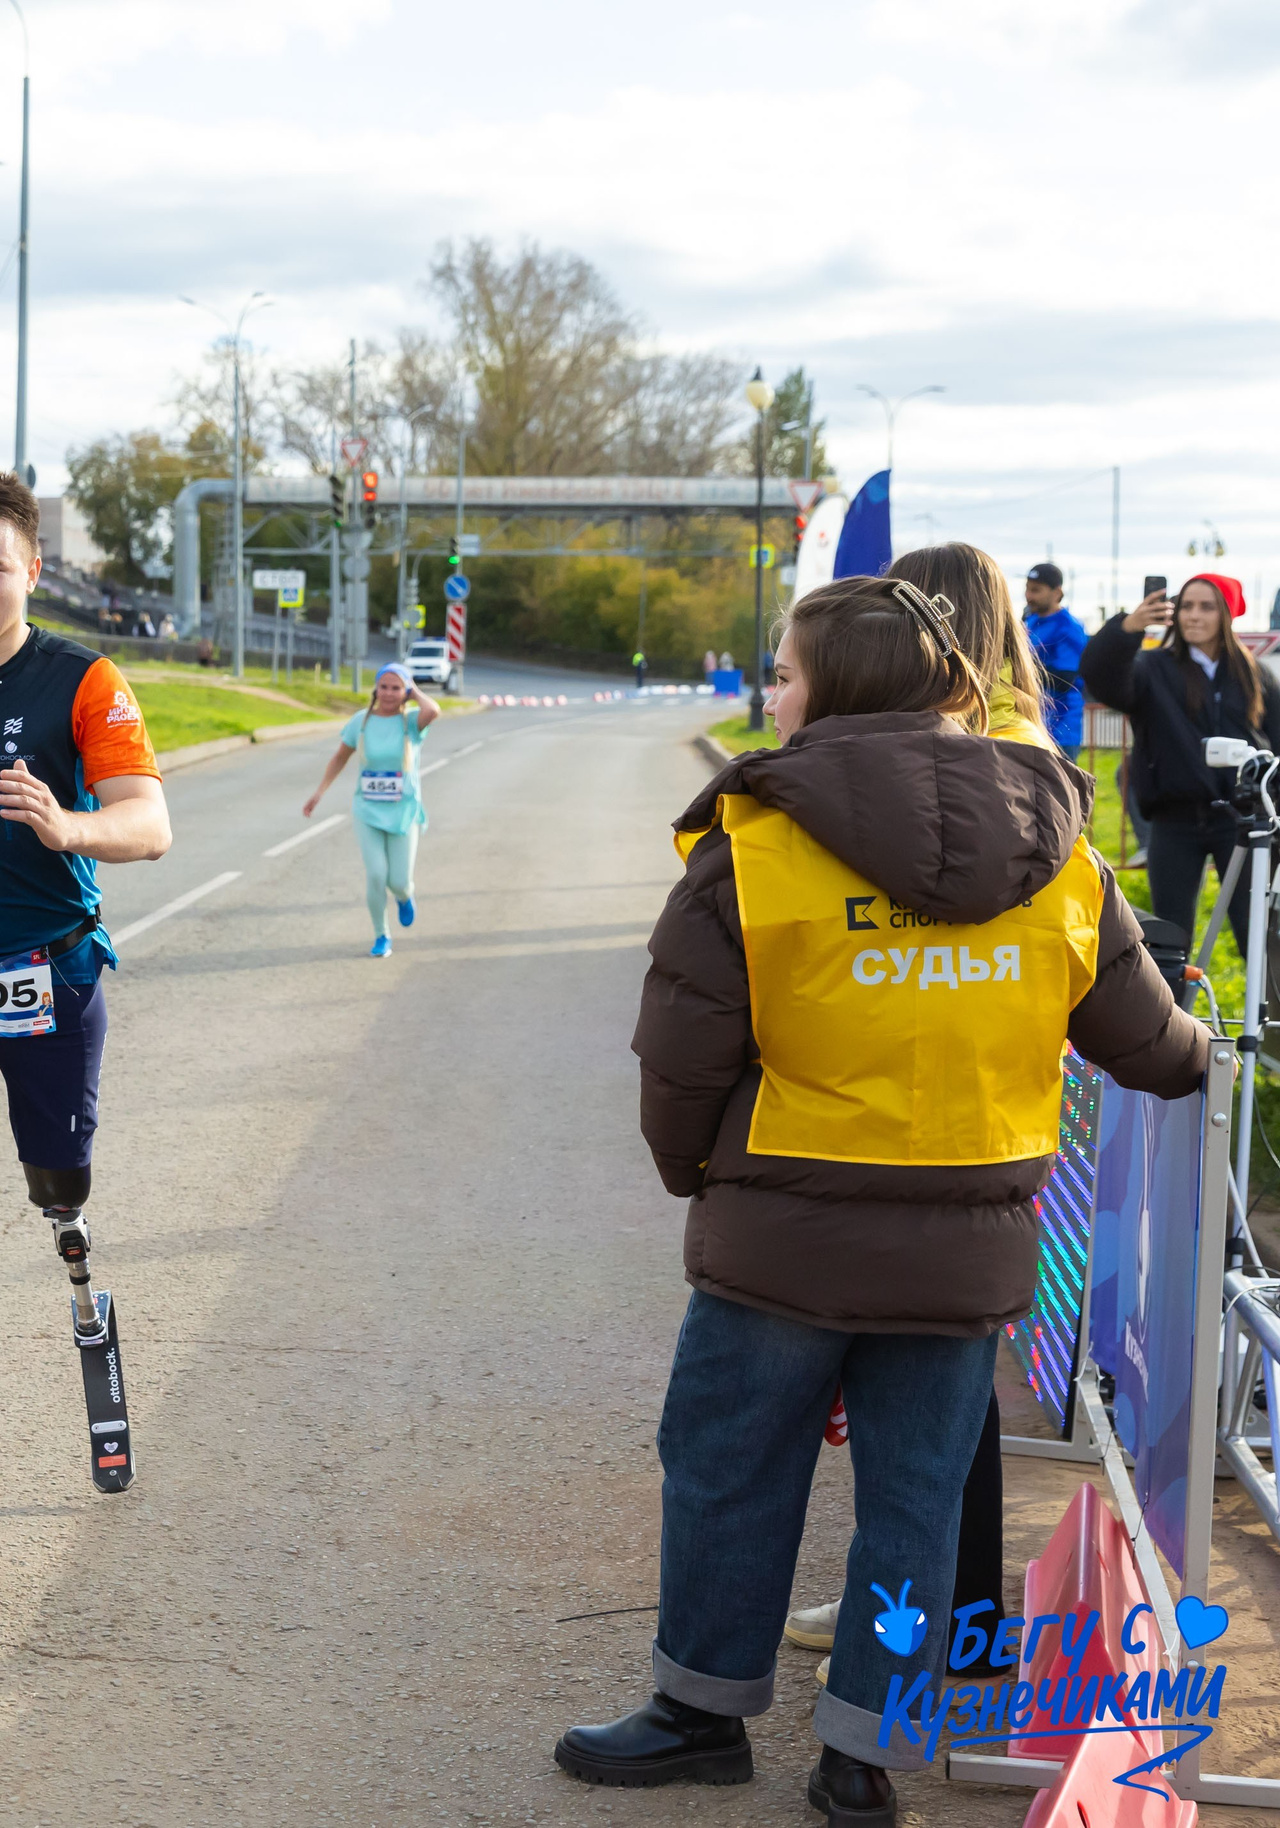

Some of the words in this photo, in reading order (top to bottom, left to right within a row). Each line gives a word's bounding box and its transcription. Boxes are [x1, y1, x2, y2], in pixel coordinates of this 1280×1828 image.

[889, 911, 954, 929] СПО
[851, 945, 1021, 990] СУДЬЯ
[105, 1347, 121, 1404] ottobock.
